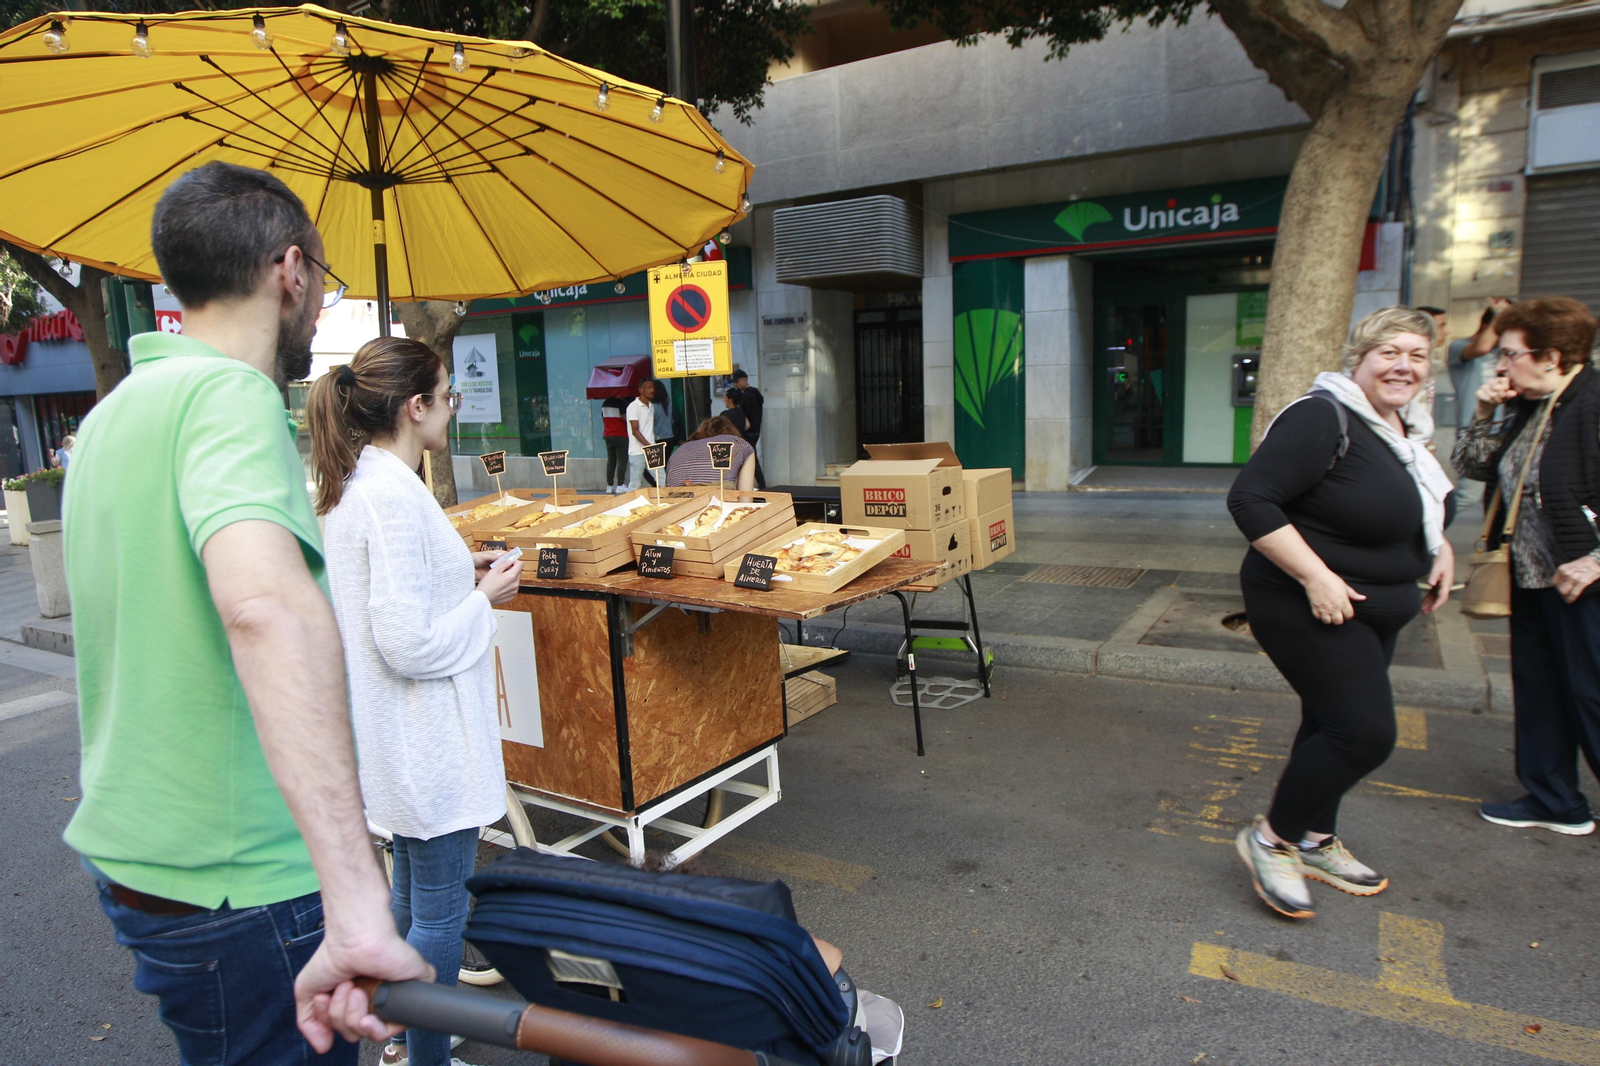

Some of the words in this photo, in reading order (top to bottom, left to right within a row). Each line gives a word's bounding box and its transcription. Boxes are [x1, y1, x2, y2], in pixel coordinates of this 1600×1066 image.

[1123, 193, 1240, 231] Unicaja
[696, 269, 722, 278] CIUDAD
[518, 348, 541, 358] Unicaja
[865, 490, 904, 501] BRICO
[989, 521, 1006, 537] BRICO
[644, 548, 662, 559] ATUN
[746, 556, 773, 570] HUERTA
[749, 567, 761, 576] DE
